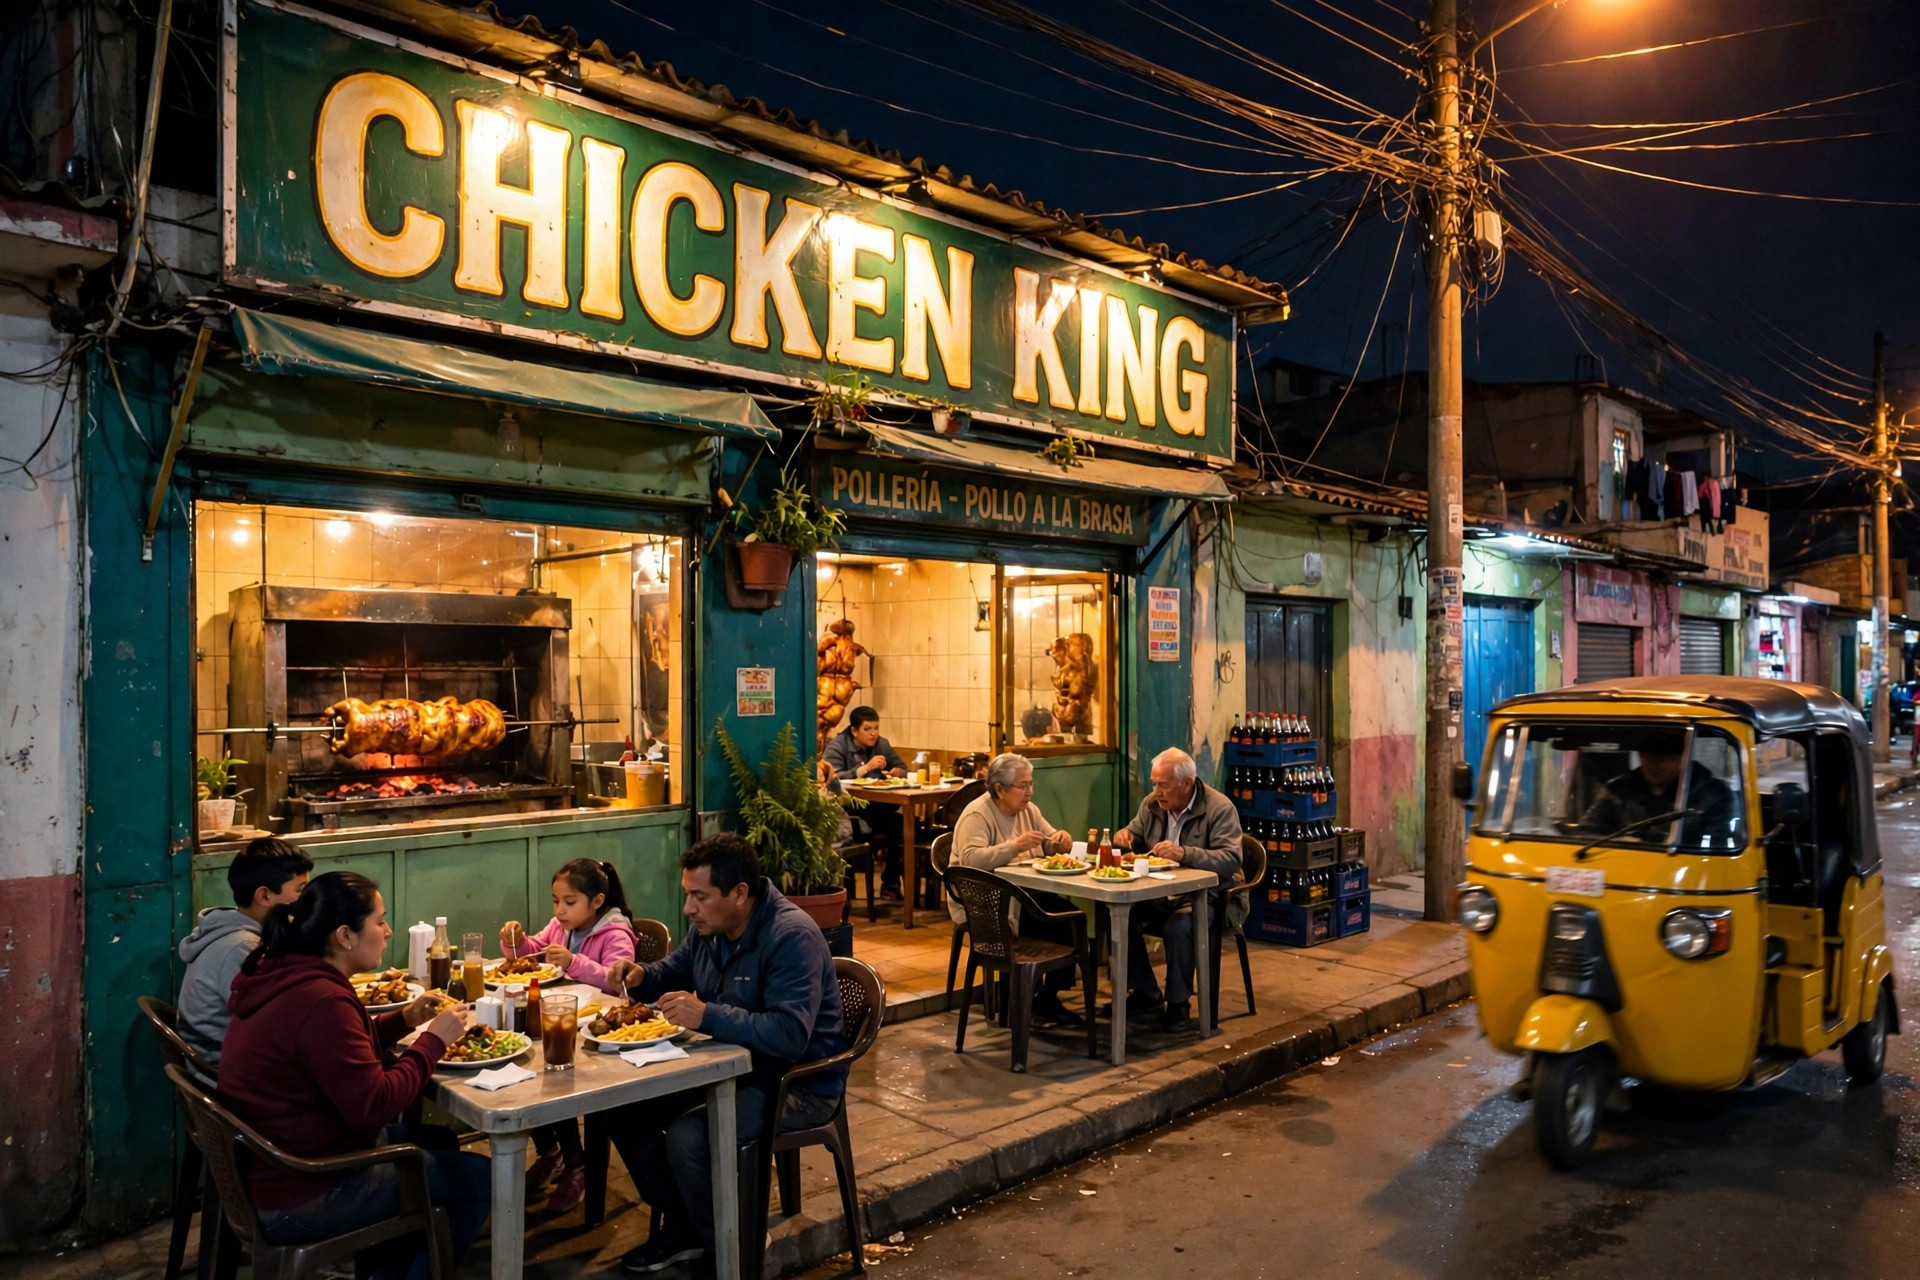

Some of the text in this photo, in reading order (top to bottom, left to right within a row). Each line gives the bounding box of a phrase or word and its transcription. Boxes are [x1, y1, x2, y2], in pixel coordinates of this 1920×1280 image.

[314, 71, 1208, 437] CHICKEN KING
[832, 466, 942, 513] POLLERÍA
[965, 484, 1027, 523] POLLO
[1032, 494, 1045, 525] A
[1051, 496, 1073, 528] LA
[1080, 499, 1133, 535] BRASA
